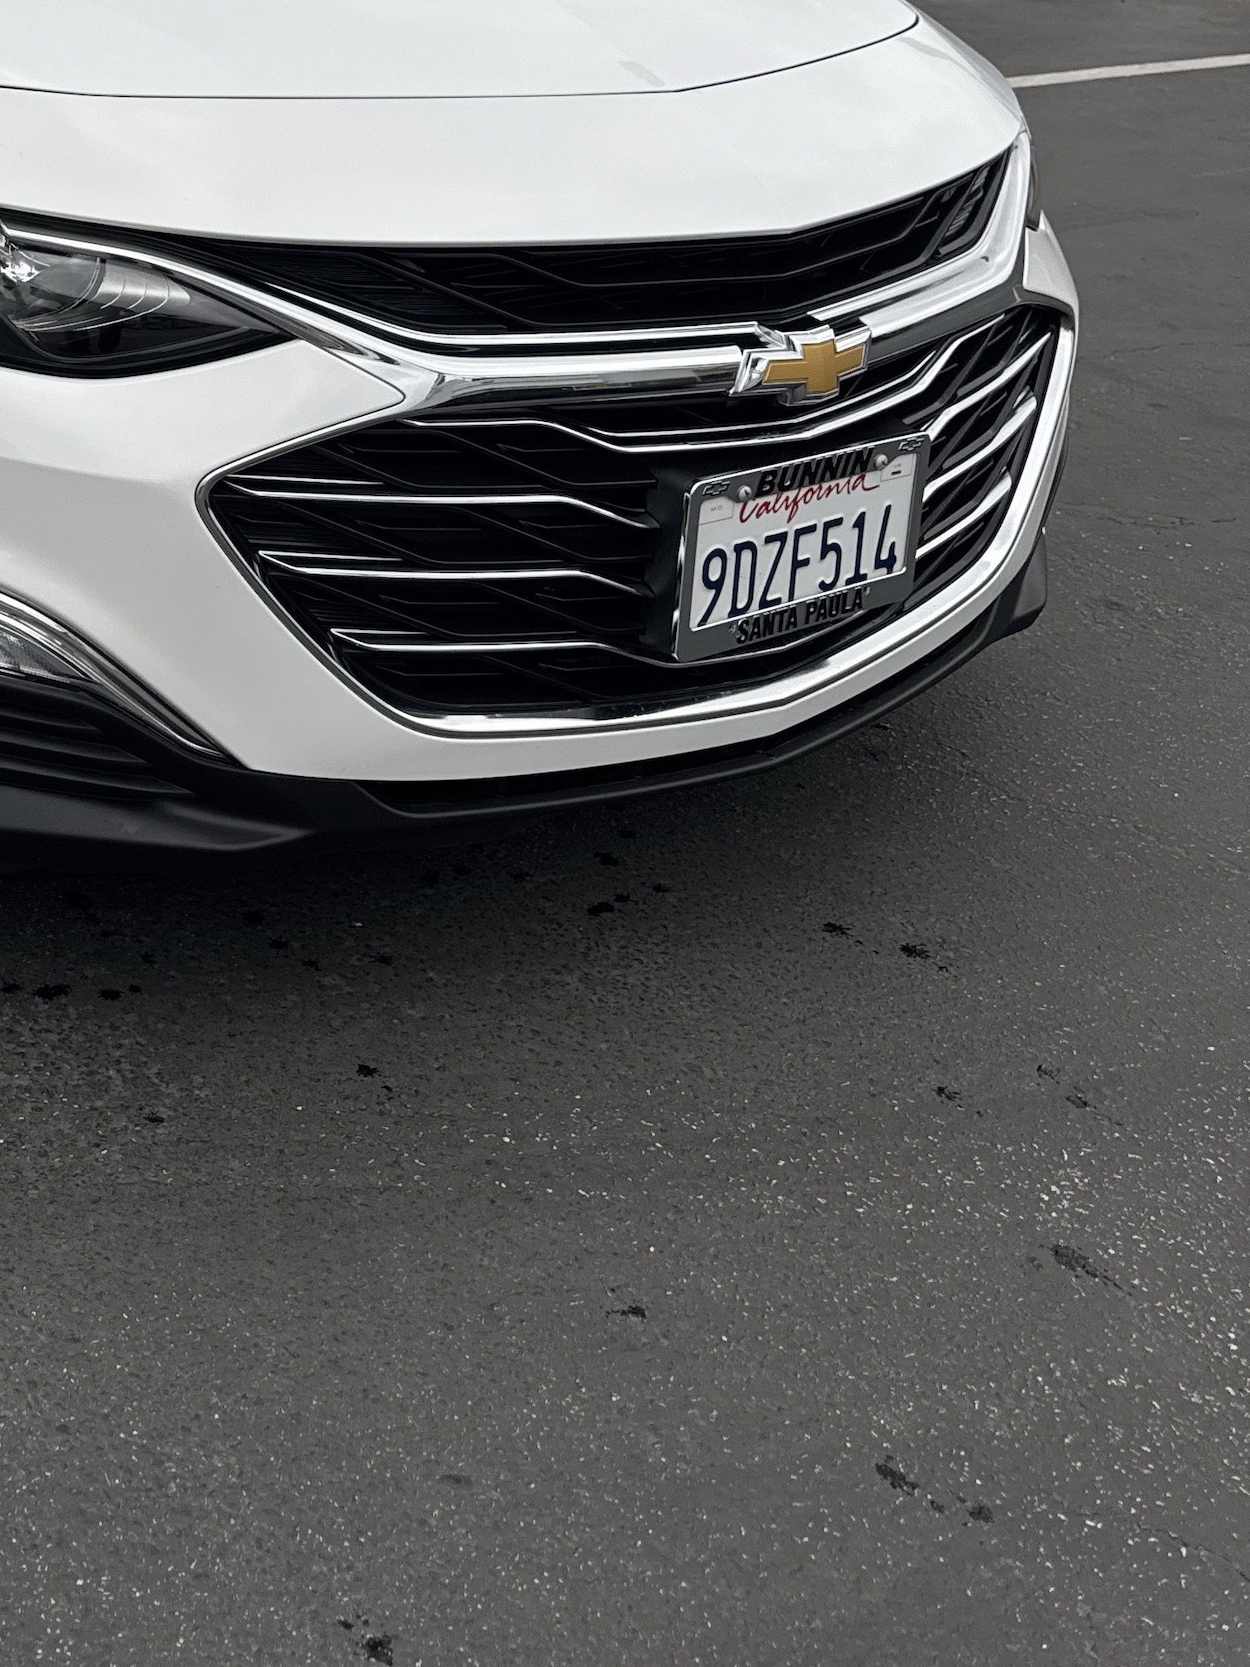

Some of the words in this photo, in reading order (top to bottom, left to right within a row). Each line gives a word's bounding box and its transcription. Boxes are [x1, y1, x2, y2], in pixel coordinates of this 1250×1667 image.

[738, 472, 880, 524] California
[755, 447, 876, 497] BUNNIN
[697, 503, 898, 628] 9DZF514
[735, 604, 798, 645] SANTA
[805, 586, 863, 626] PAULA
